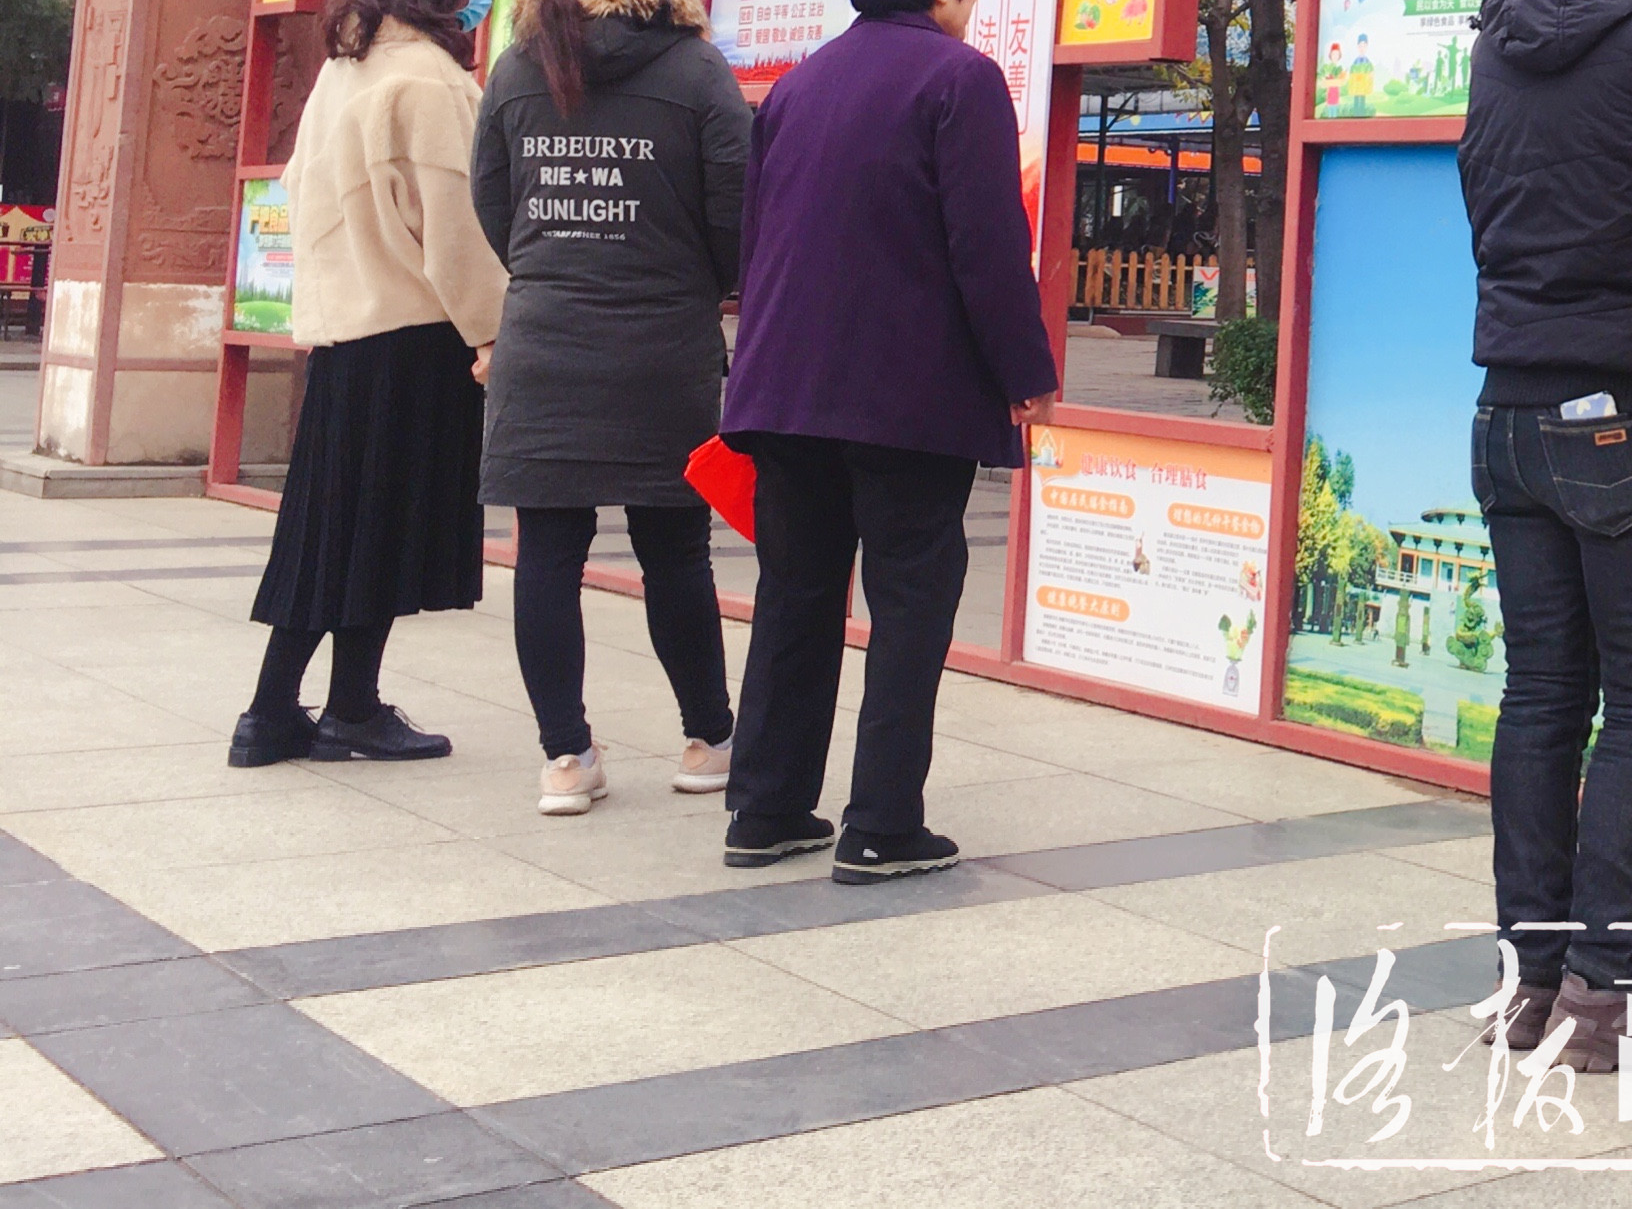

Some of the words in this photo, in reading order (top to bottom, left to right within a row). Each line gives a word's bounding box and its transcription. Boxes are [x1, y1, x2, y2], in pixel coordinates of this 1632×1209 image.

[757, 7, 771, 21] 自由
[773, 5, 789, 20] 平等
[791, 3, 807, 18] 公正
[809, 2, 824, 17] 法治
[807, 25, 822, 40] 友善
[1007, 13, 1030, 102] 友善
[521, 136, 655, 160] BRBEURYR
[528, 197, 640, 222] SUNLIGHT
[1081, 453, 1137, 481] 健康饮食
